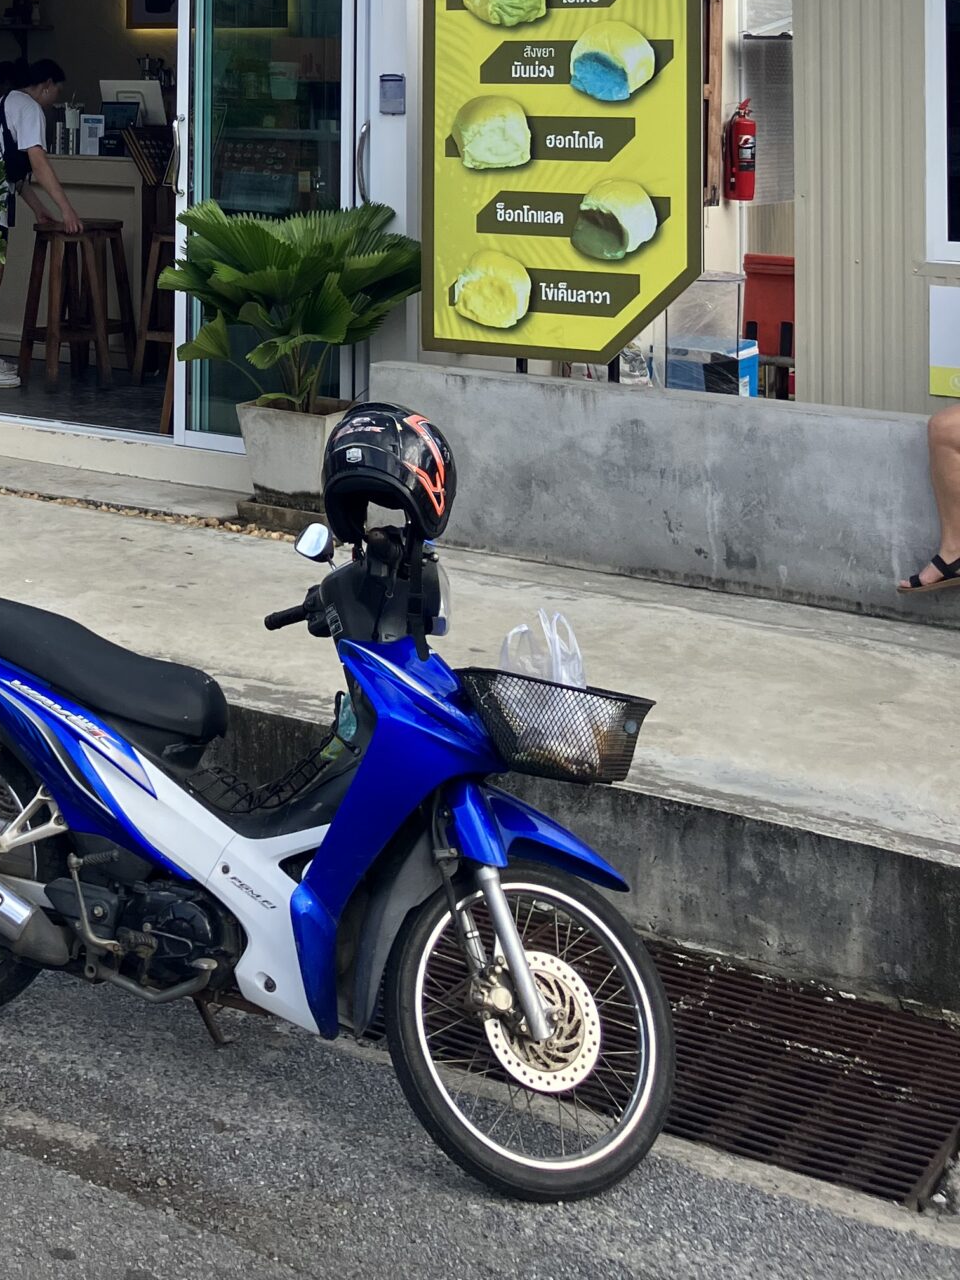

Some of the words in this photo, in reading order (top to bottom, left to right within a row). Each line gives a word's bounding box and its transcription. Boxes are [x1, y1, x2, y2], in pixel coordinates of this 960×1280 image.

[523, 45, 555, 58] สังขยา
[511, 61, 555, 78] มันม่วง
[546, 131, 604, 149] ฮอกไกโด
[495, 202, 564, 224] ช็อกโกแลต
[539, 282, 611, 305] ไข่เค็มลาวา
